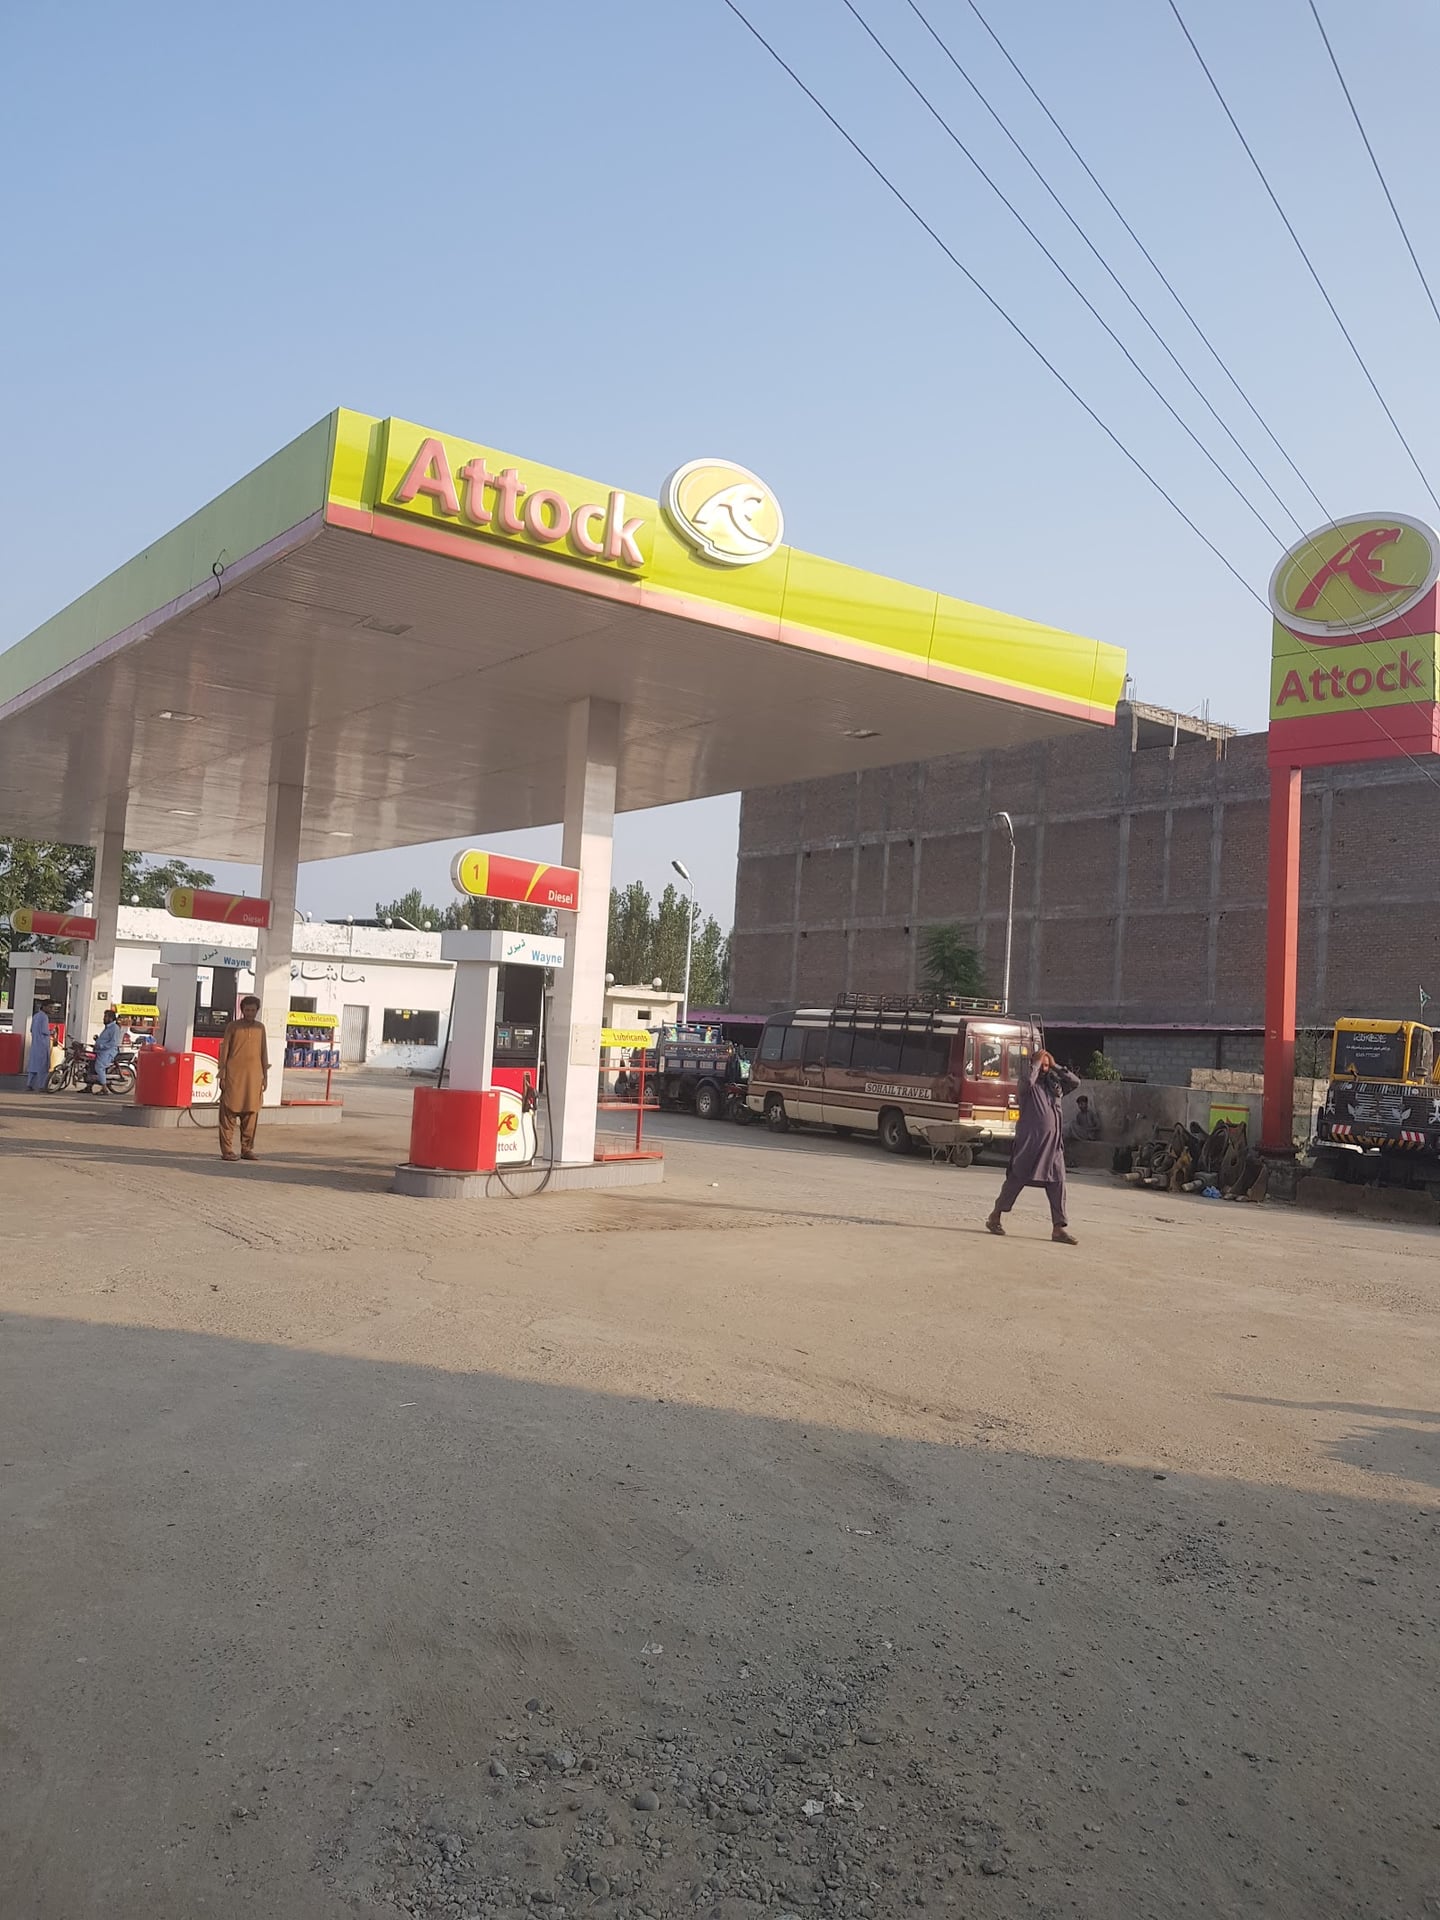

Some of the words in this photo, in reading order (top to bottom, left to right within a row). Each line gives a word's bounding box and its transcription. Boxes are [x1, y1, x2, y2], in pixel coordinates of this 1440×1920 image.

[394, 437, 646, 567] Attock
[1276, 650, 1425, 706] Attock
[473, 864, 479, 880] 1
[180, 896, 187, 908] 3
[548, 890, 573, 904] Diesel
[243, 913, 264, 925] Diesel
[223, 956, 251, 968] Wayne
[532, 950, 562, 965] Wayne
[56, 962, 79, 970] Wayne
[304, 1015, 336, 1024] Lubricants
[613, 1033, 648, 1042] Lubricants
[866, 1083, 896, 1095] SOHAIL
[896, 1086, 930, 1099] TRAVEL
[498, 1141, 517, 1152] ttock
